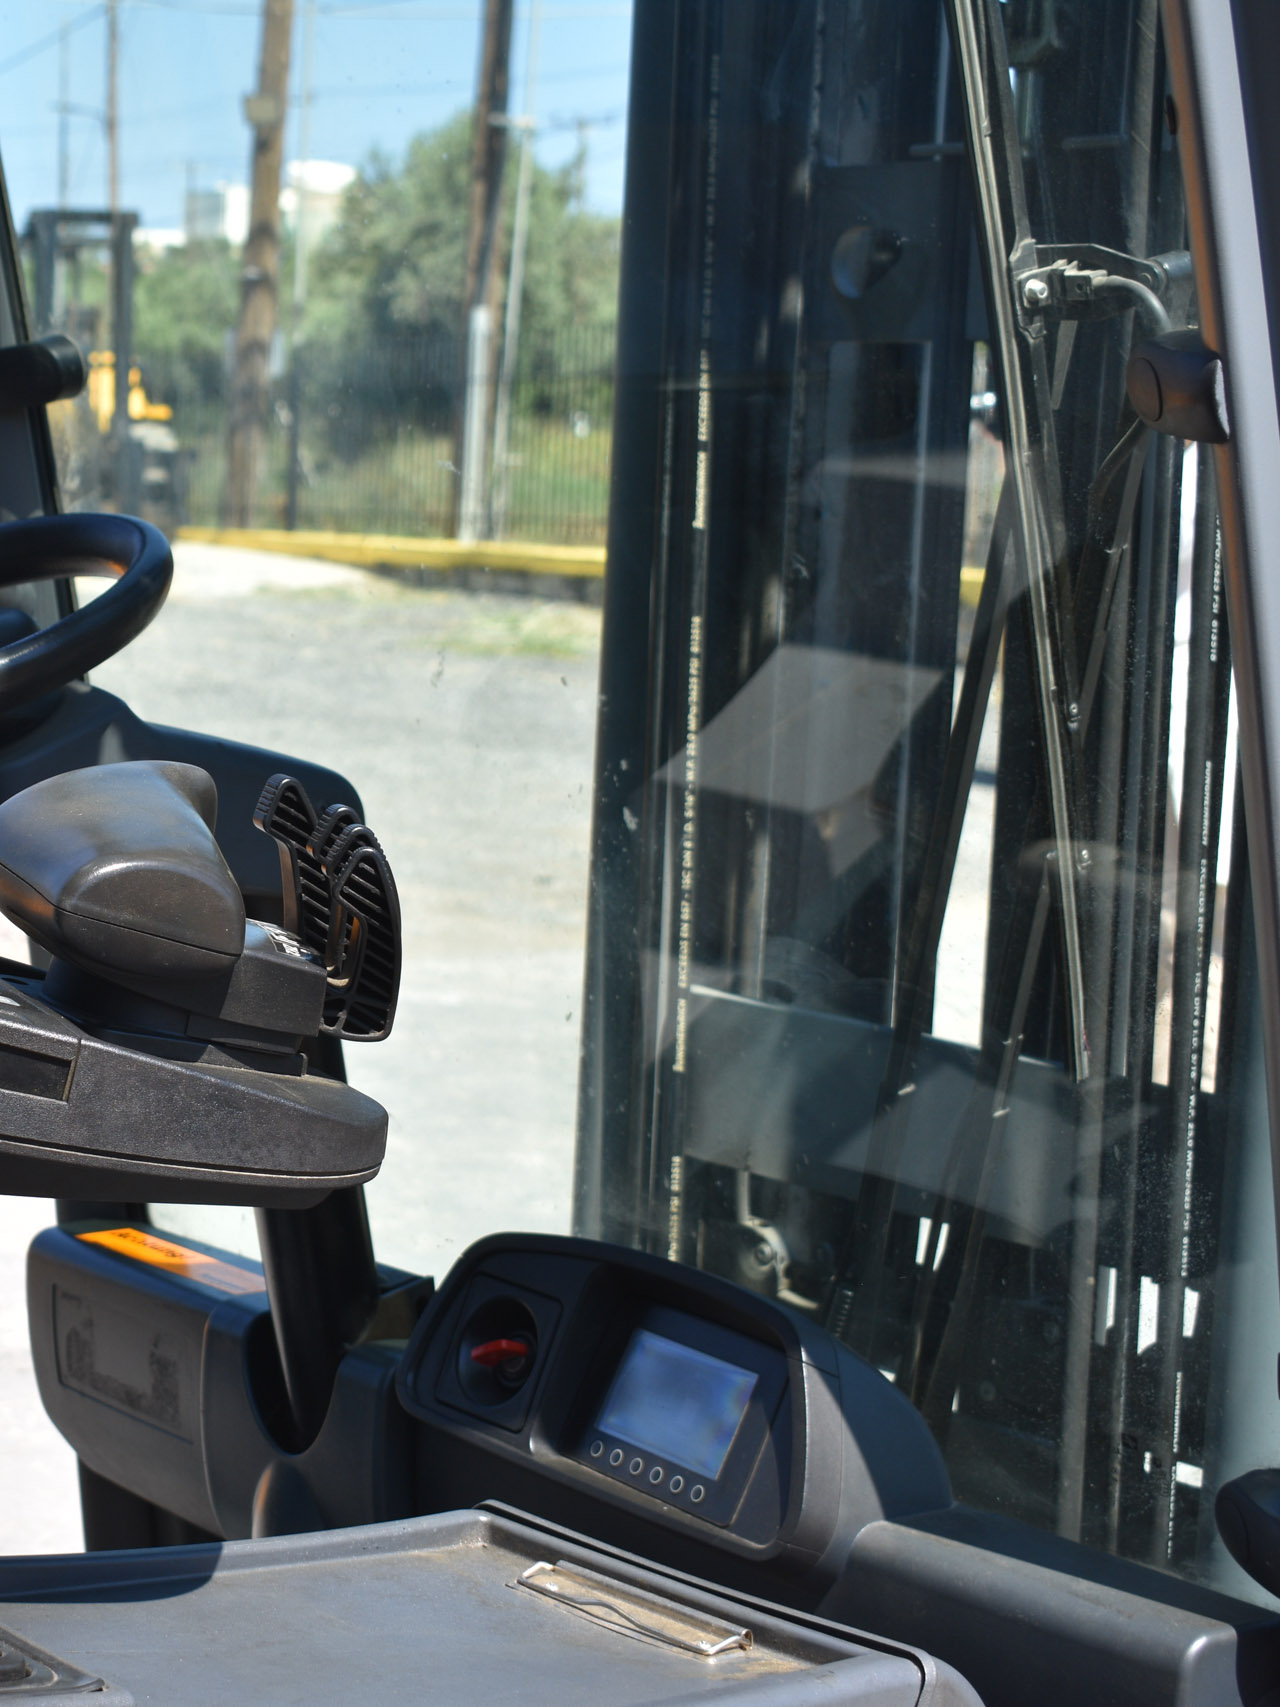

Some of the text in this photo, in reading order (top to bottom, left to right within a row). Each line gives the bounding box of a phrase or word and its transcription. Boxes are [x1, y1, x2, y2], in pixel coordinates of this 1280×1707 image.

[689, 657, 700, 675] PSI
[679, 922, 691, 938] EN
[677, 940, 690, 988] EXCEEDS
